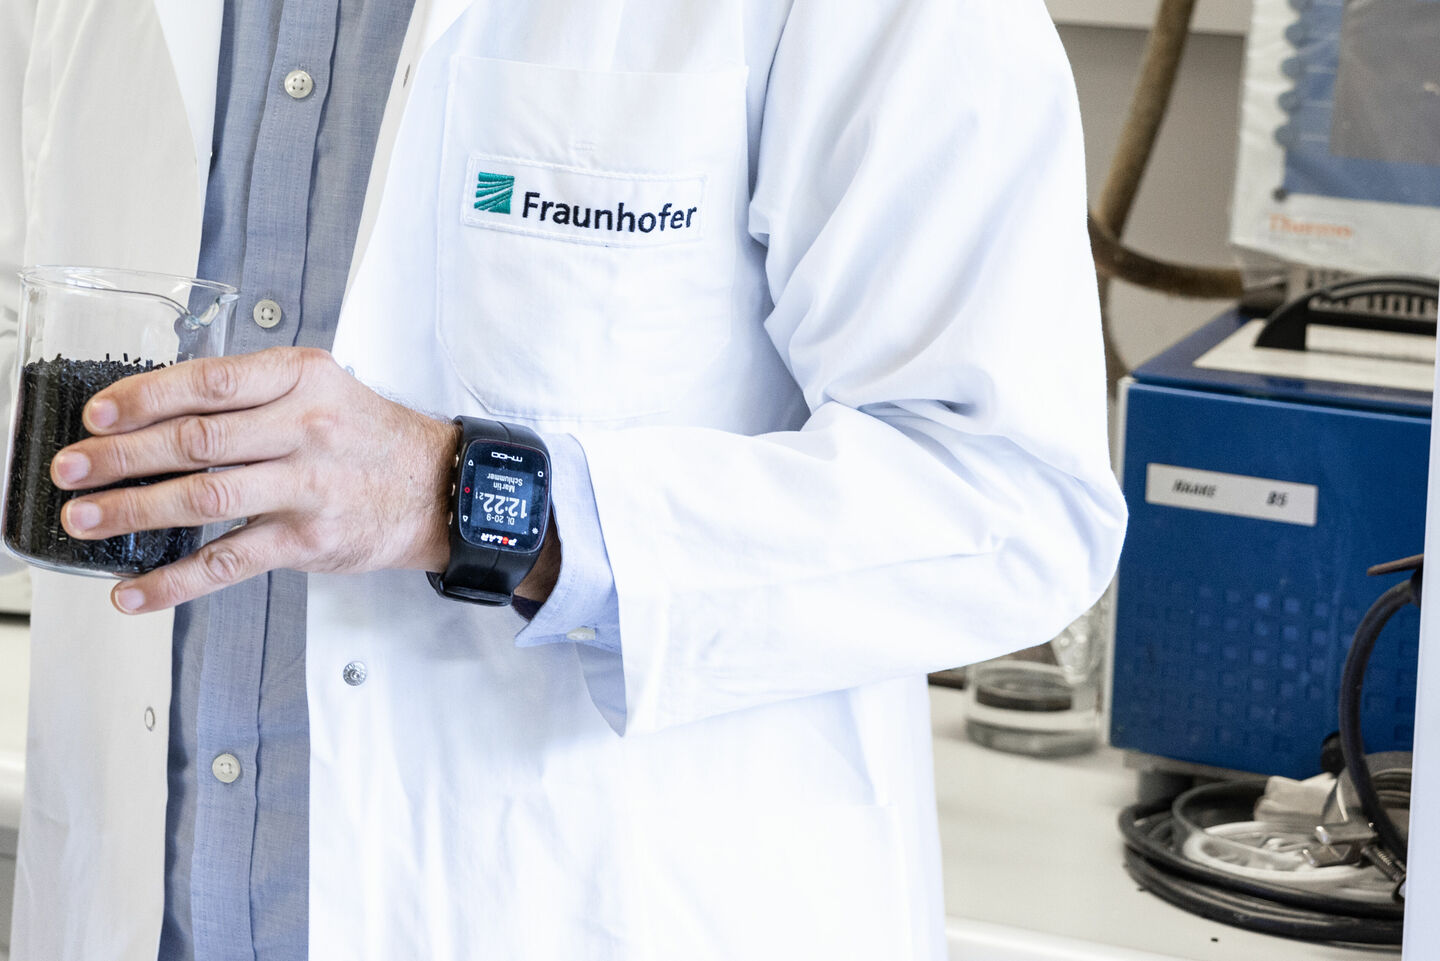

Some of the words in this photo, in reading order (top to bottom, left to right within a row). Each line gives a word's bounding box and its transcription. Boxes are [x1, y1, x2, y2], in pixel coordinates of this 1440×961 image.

[522, 191, 697, 233] Fraunhofer
[487, 473, 523, 486] Schlummer
[493, 482, 515, 493] Martin
[483, 493, 527, 519] 12:22
[480, 533, 517, 546] POLAR
